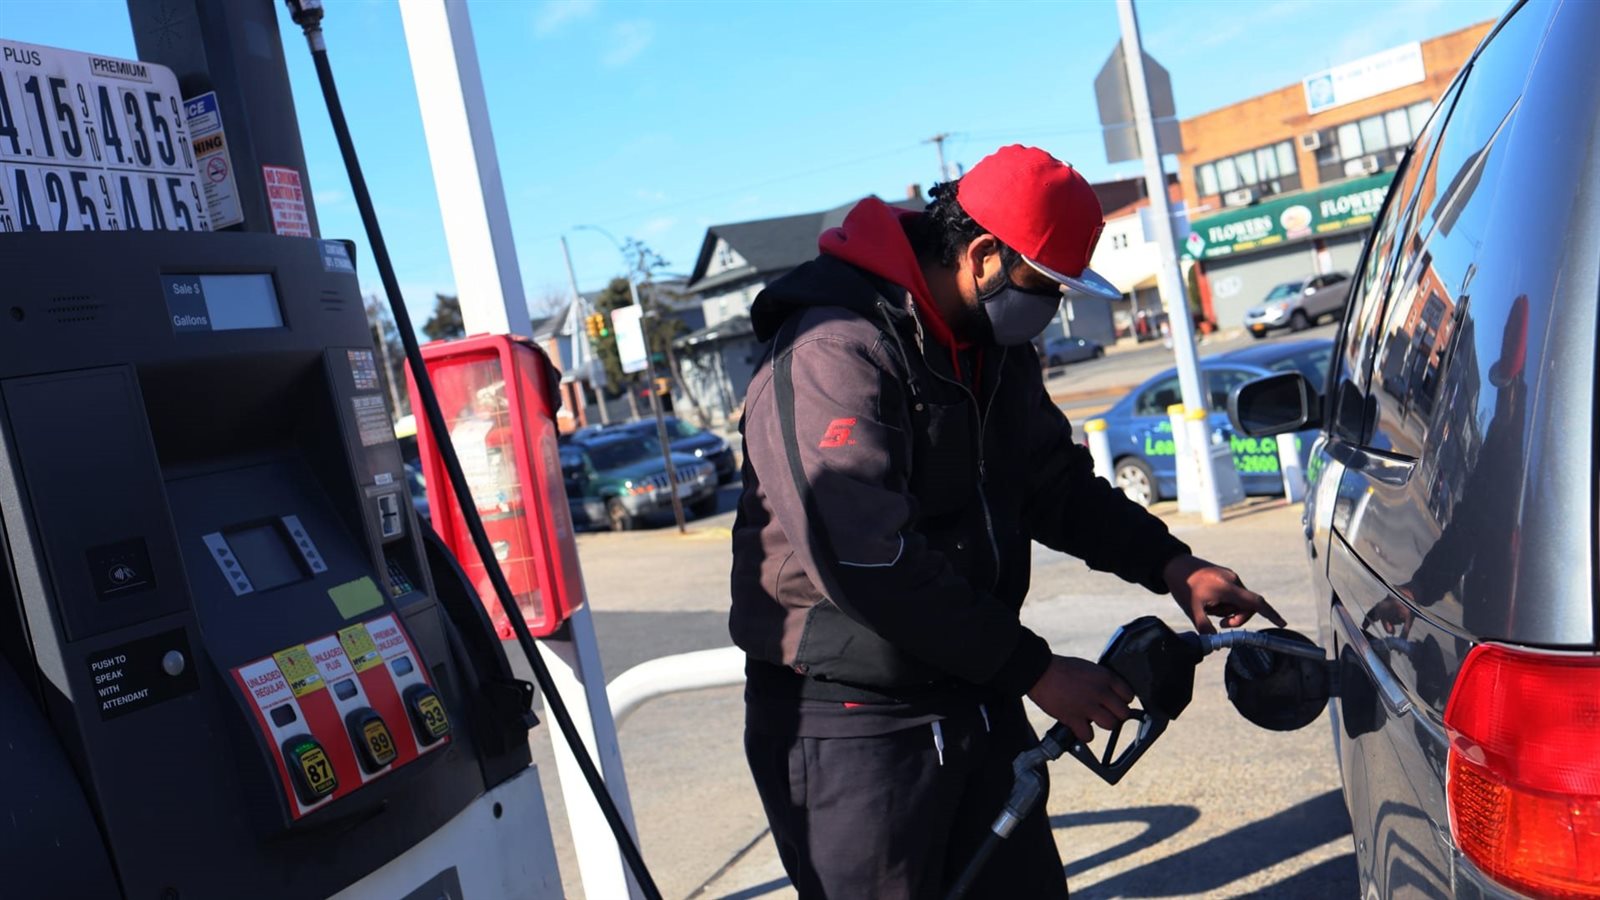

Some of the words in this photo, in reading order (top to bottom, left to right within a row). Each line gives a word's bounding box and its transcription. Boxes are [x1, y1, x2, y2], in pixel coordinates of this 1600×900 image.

[3, 47, 41, 66] PLUS
[93, 58, 148, 78] PREMIUM
[98, 86, 176, 166] 4.35
[194, 136, 223, 155] NING
[1208, 215, 1273, 243] FLOWERS
[173, 283, 193, 294] Sale
[173, 315, 207, 326] Gallons
[92, 659, 115, 671] PUSH
[115, 655, 126, 665] TO
[313, 647, 343, 664] UNLEADED
[324, 659, 342, 672] PLUS
[95, 669, 123, 684] SPEAK
[246, 669, 281, 688] UNLEADED
[98, 684, 120, 697] WITH
[103, 689, 148, 709] ATTENDANT
[254, 681, 286, 698] REGULAR
[425, 706, 444, 727] 93
[370, 732, 390, 753] 89
[306, 759, 330, 785] 87
